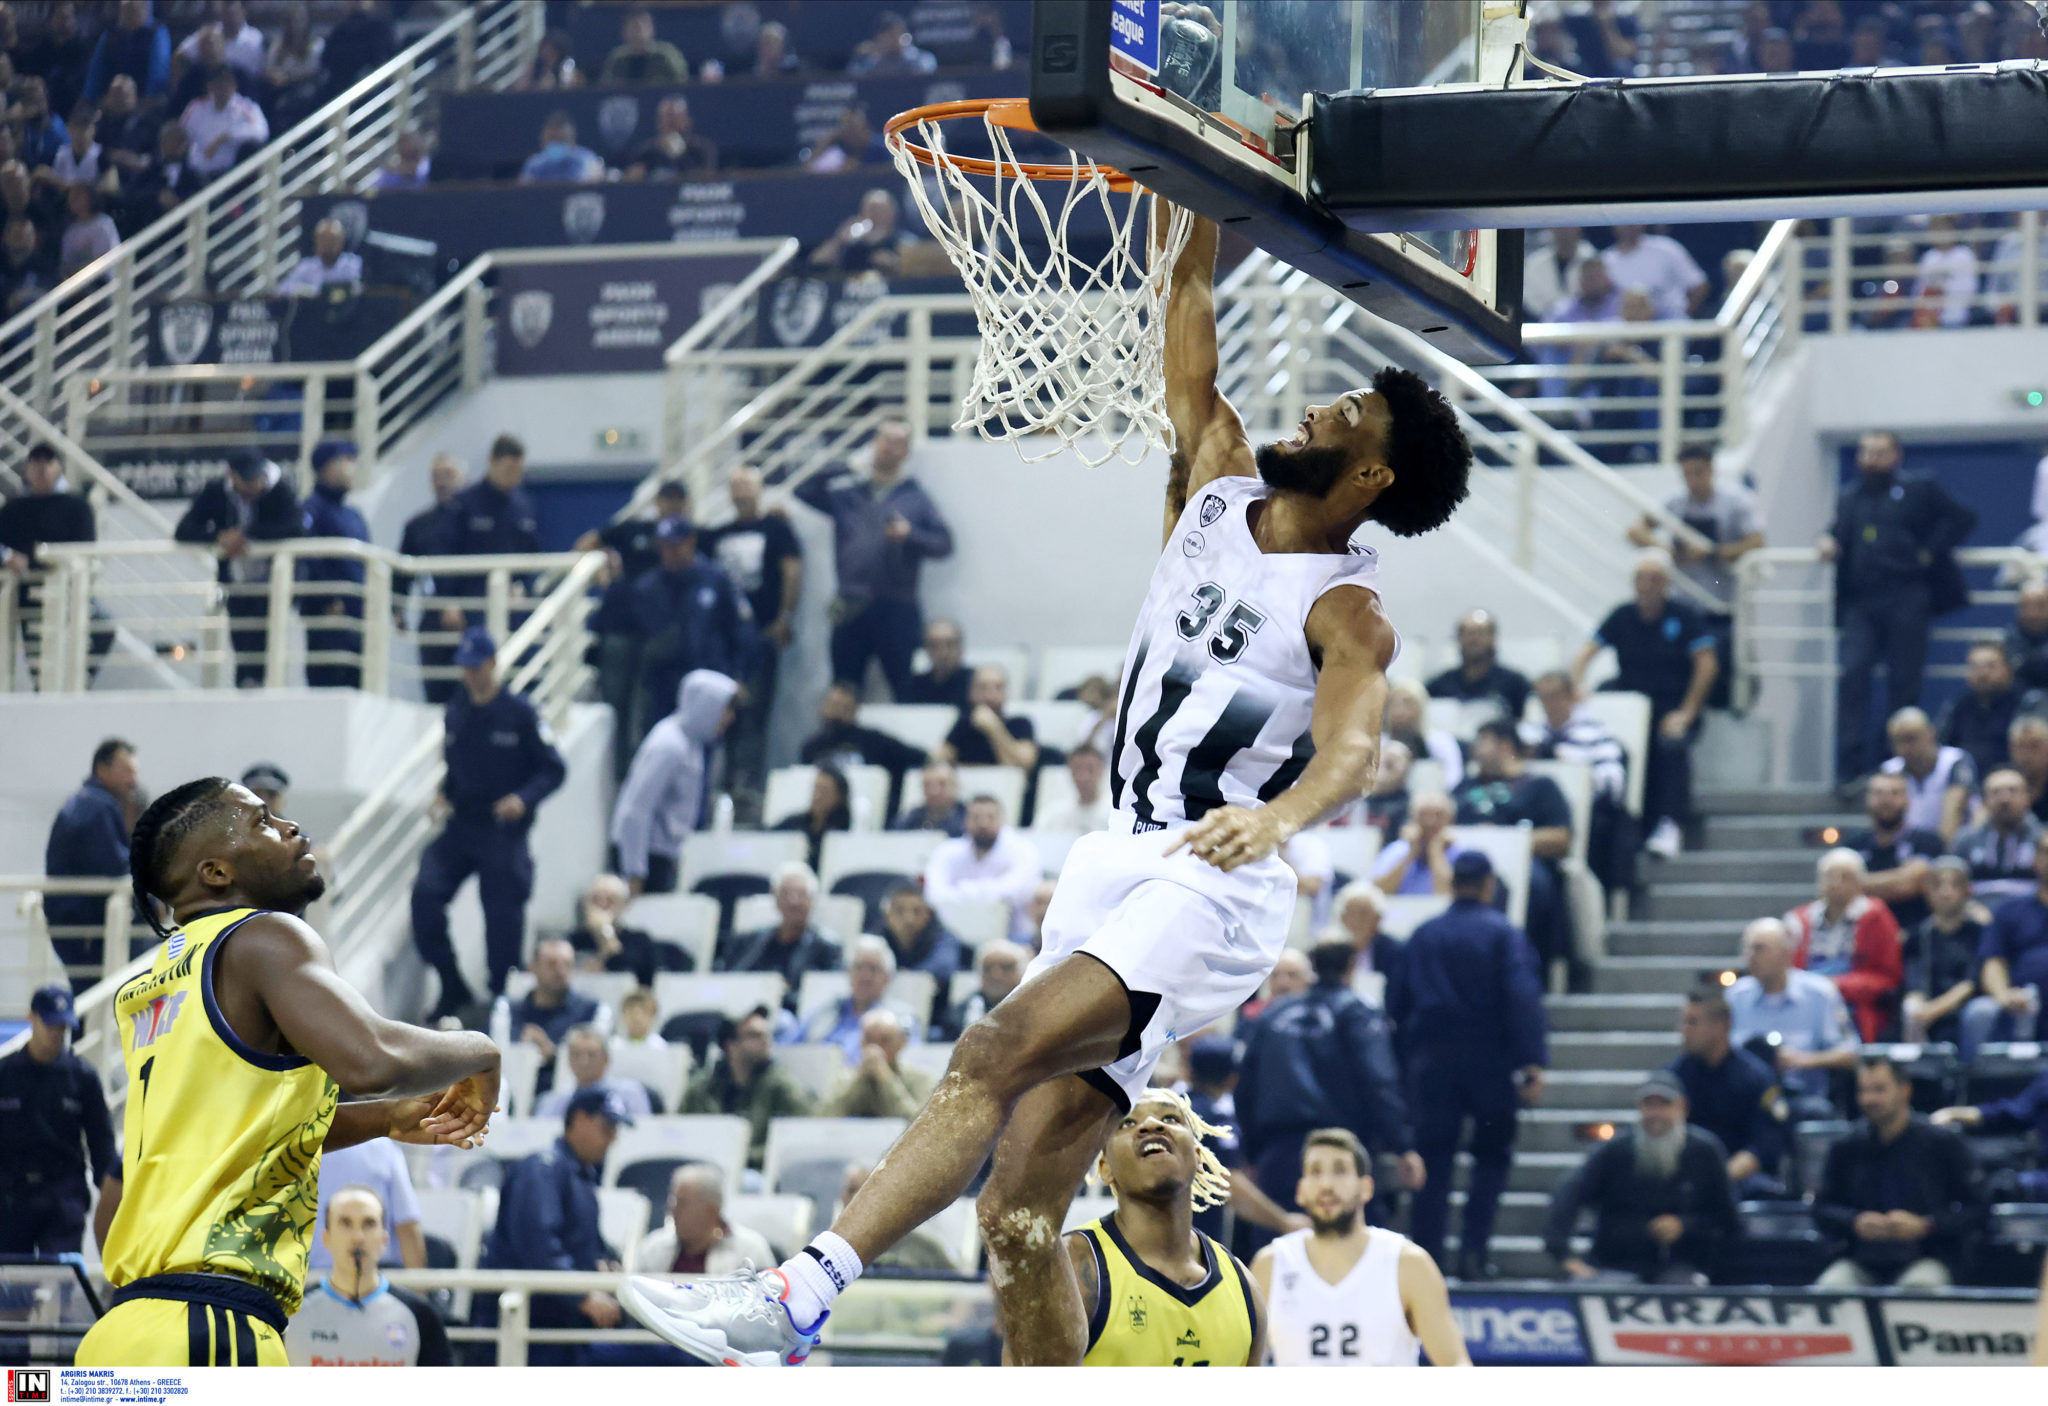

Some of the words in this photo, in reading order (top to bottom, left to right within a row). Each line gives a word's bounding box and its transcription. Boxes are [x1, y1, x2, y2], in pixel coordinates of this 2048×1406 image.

[1111, 11, 1145, 45] eague
[1175, 581, 1268, 666] 35
[1604, 1295, 1843, 1326] KRAFT
[1310, 1322, 1360, 1356] 22
[1894, 1321, 2030, 1355] Pana
